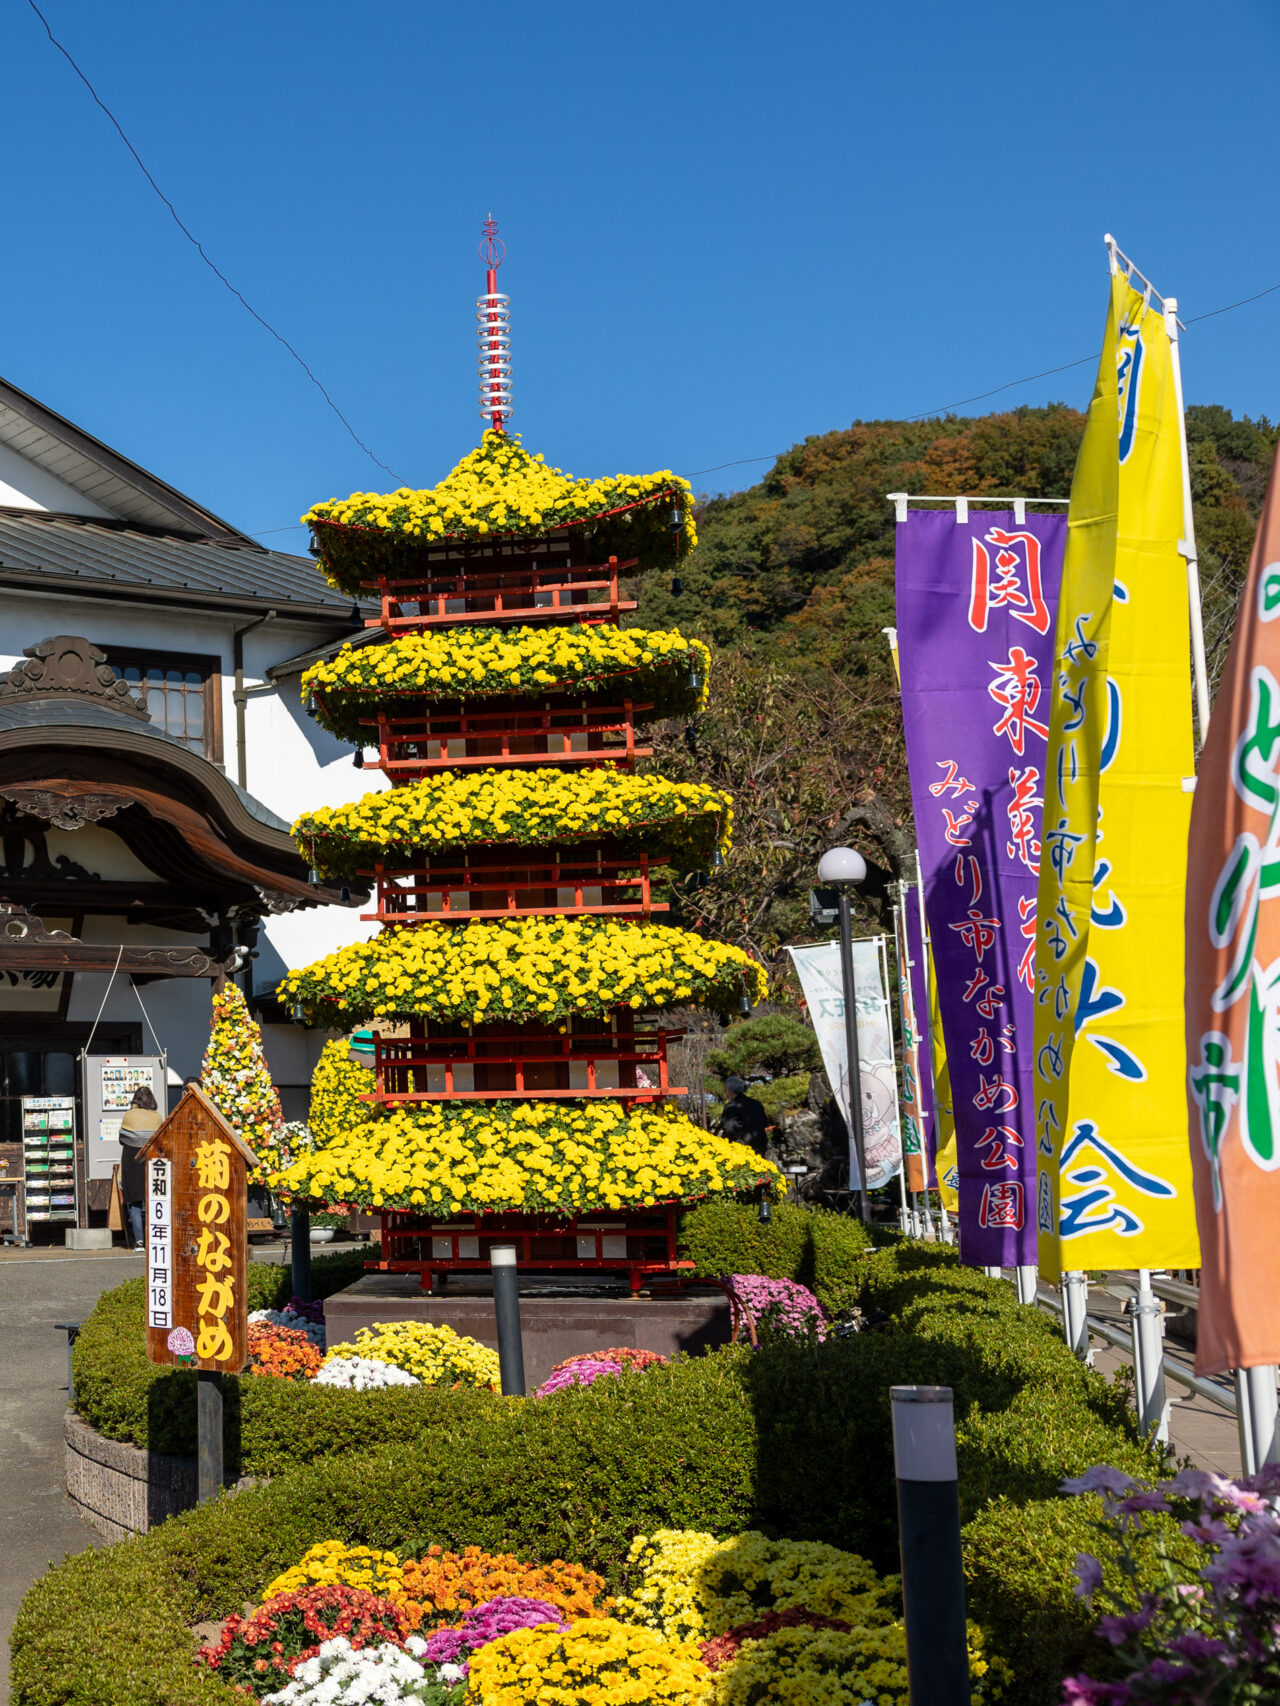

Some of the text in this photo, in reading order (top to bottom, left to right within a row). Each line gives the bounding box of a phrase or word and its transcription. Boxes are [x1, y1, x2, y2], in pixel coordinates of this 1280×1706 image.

[928, 760, 1025, 1232] みどり市ながめ公園
[151, 1159, 168, 1327] 令和6年11月18日
[195, 1138, 235, 1361] 菊のながめ
